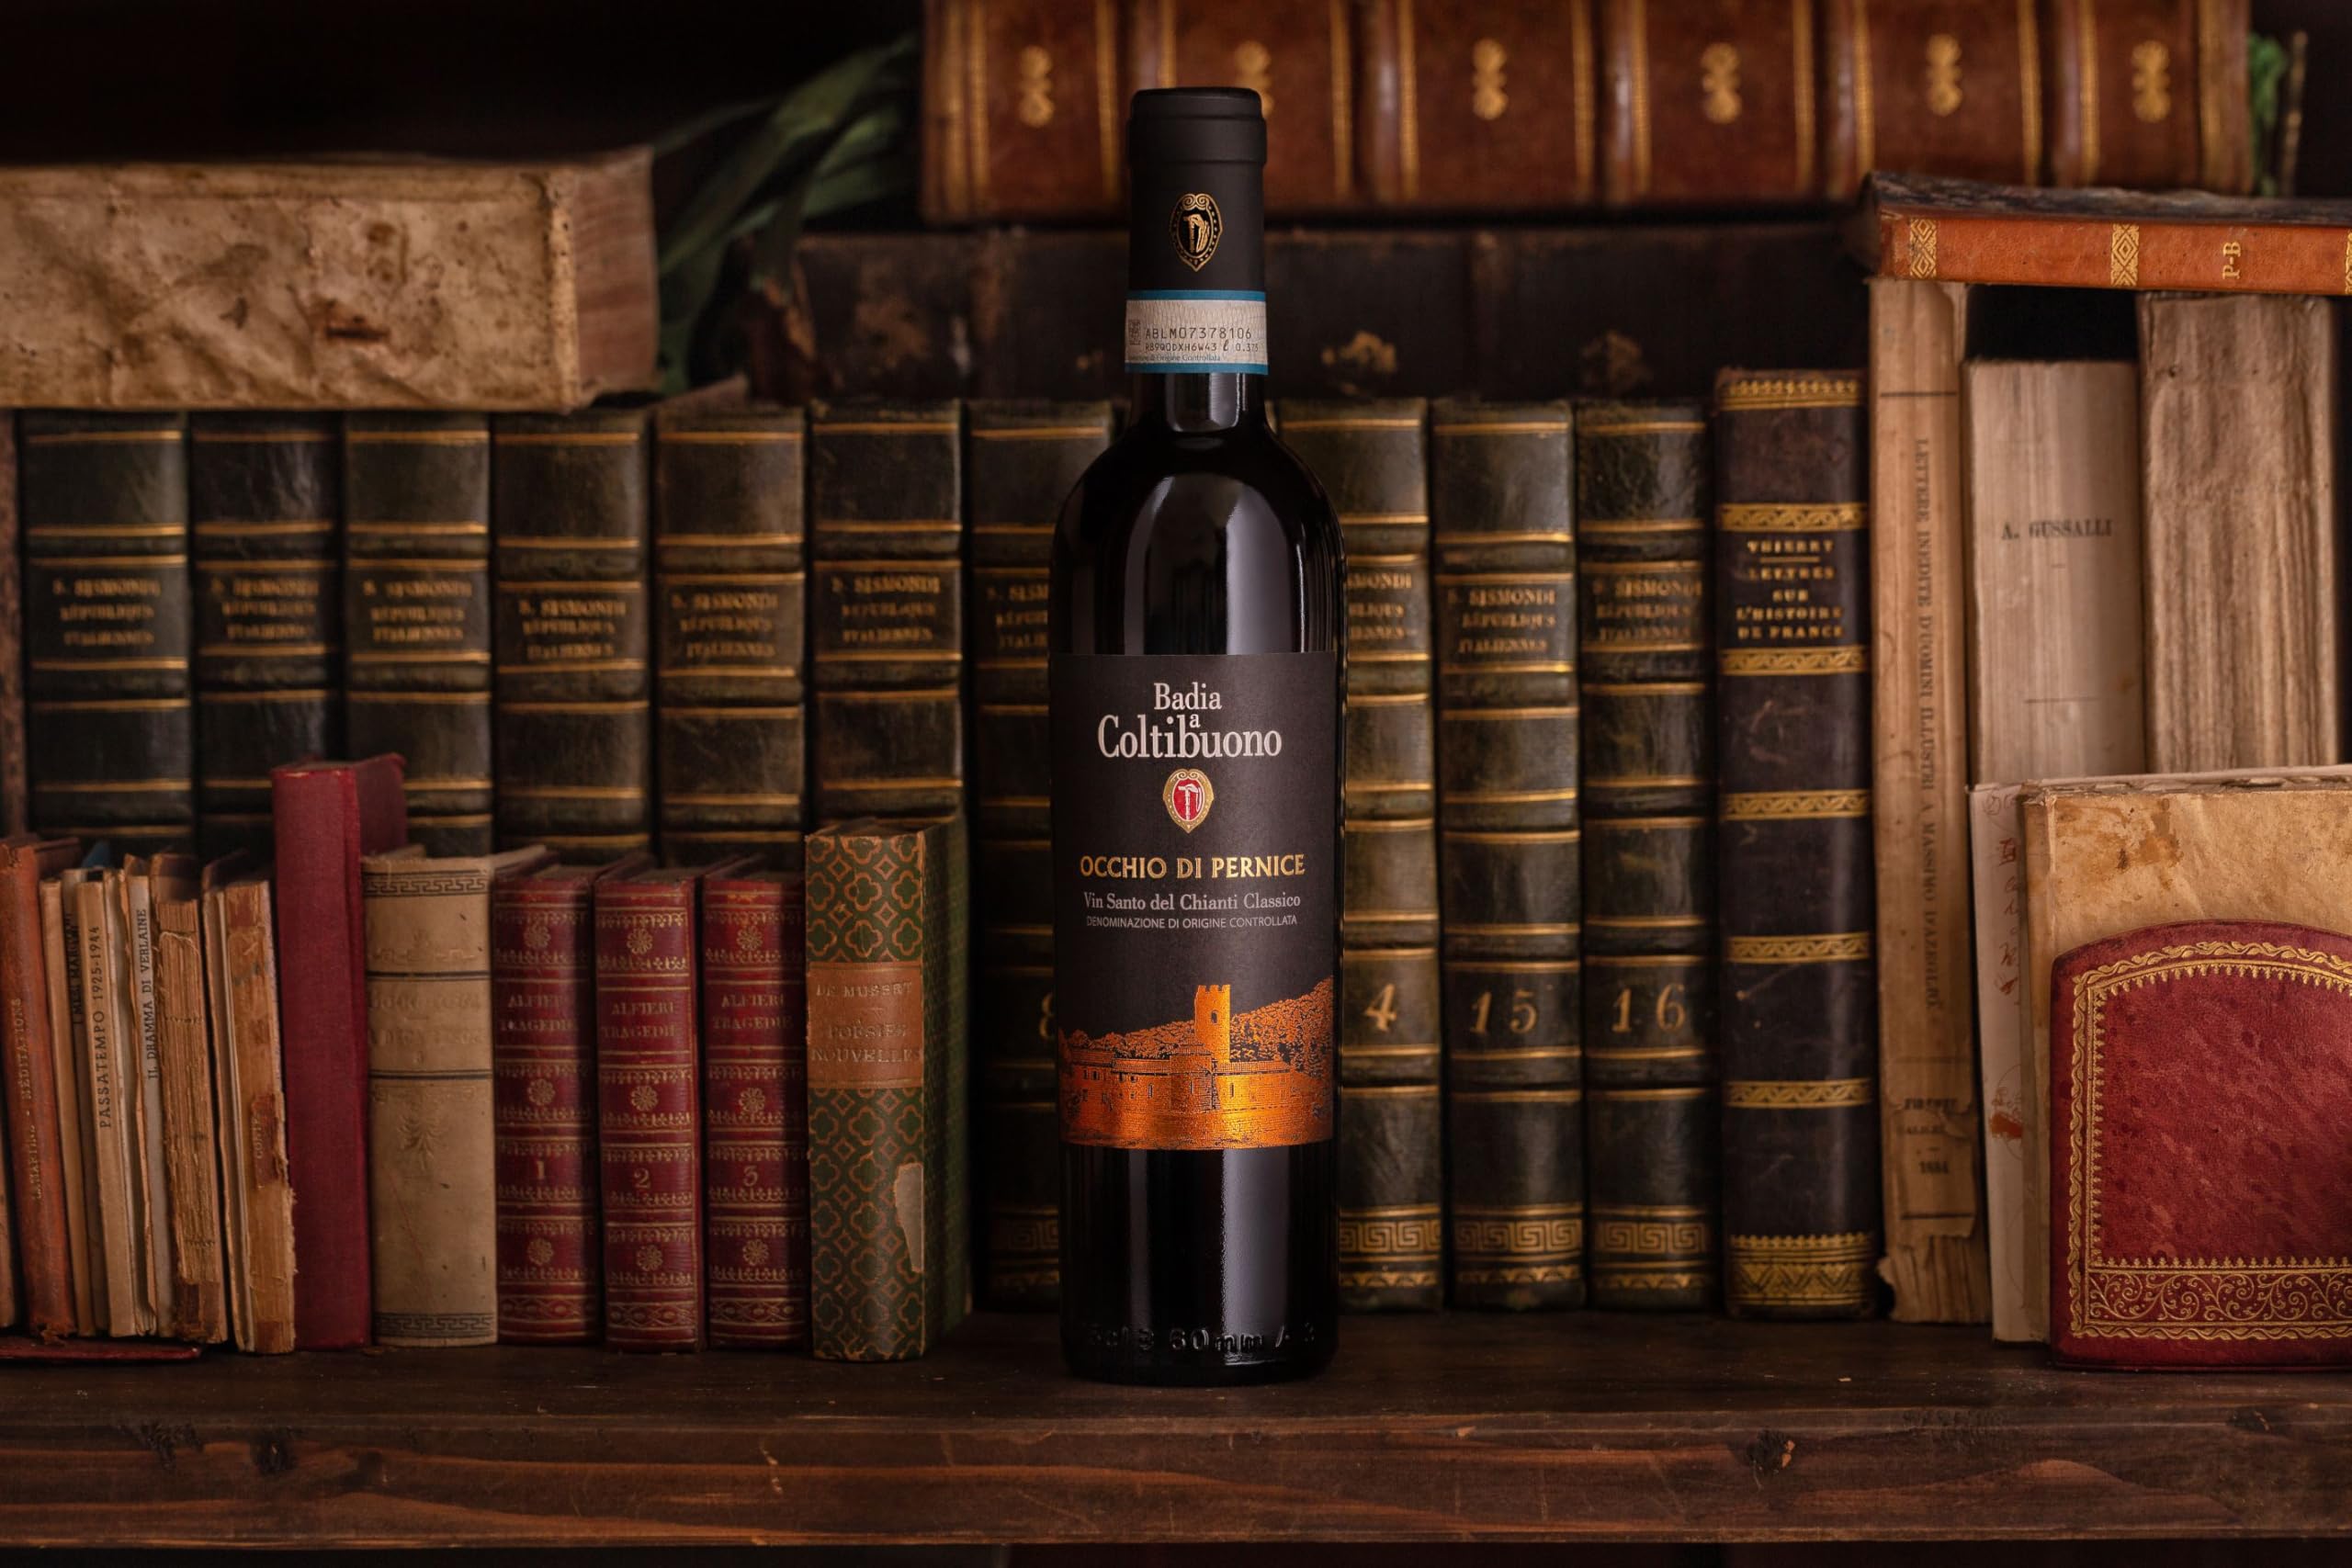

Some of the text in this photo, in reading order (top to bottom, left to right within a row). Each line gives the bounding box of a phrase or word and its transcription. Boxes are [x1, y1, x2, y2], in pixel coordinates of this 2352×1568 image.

[2222, 242, 2242, 280] P-B
[1153, 682, 1223, 710] Badia
[1189, 713, 1201, 728] a
[1097, 714, 1283, 758] Coltibuono
[1080, 854, 1306, 879] OCCHIO DI PERNICE
[1083, 891, 1302, 910] Vin Santo del Chianti Classico
[1086, 915, 1298, 930] DENOMINAZIONE DI ORIGINE CONTROLLATA
[136, 908, 159, 1080] IL DRAMMA DI VERLAINE
[843, 981, 913, 998] MUSSET
[610, 1001, 676, 1016] ALFIERI
[1469, 988, 1539, 1035] 15
[1611, 982, 1687, 1034] 16
[88, 926, 111, 1128] PASSATEMPO 1925-1944
[536, 1160, 546, 1180] 1
[632, 1168, 651, 1190] 2
[743, 1165, 761, 1188] 3
